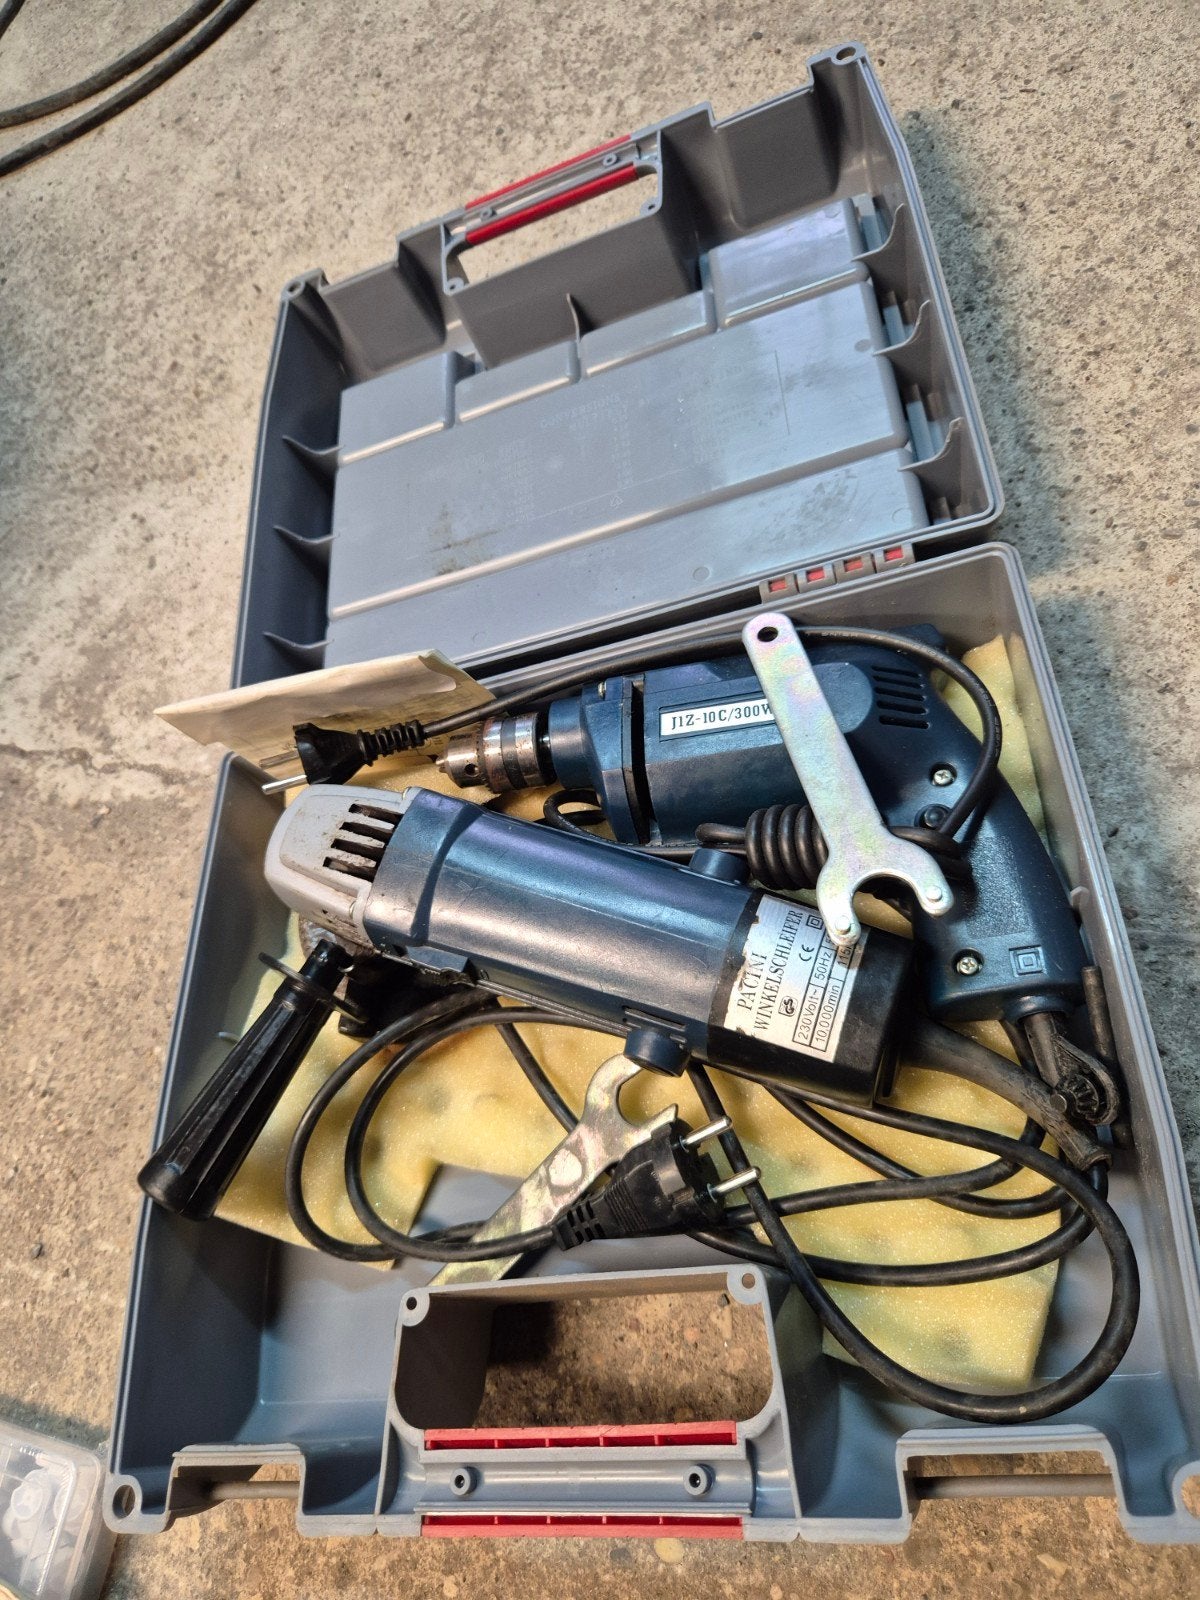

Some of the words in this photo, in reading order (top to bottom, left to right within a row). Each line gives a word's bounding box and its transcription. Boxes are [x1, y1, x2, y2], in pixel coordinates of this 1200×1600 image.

[754, 910, 804, 1030] WINKELSCHLEIFER
[814, 951, 833, 981] 50Hz
[837, 945, 853, 966] 115
[737, 952, 767, 1011] PACINI
